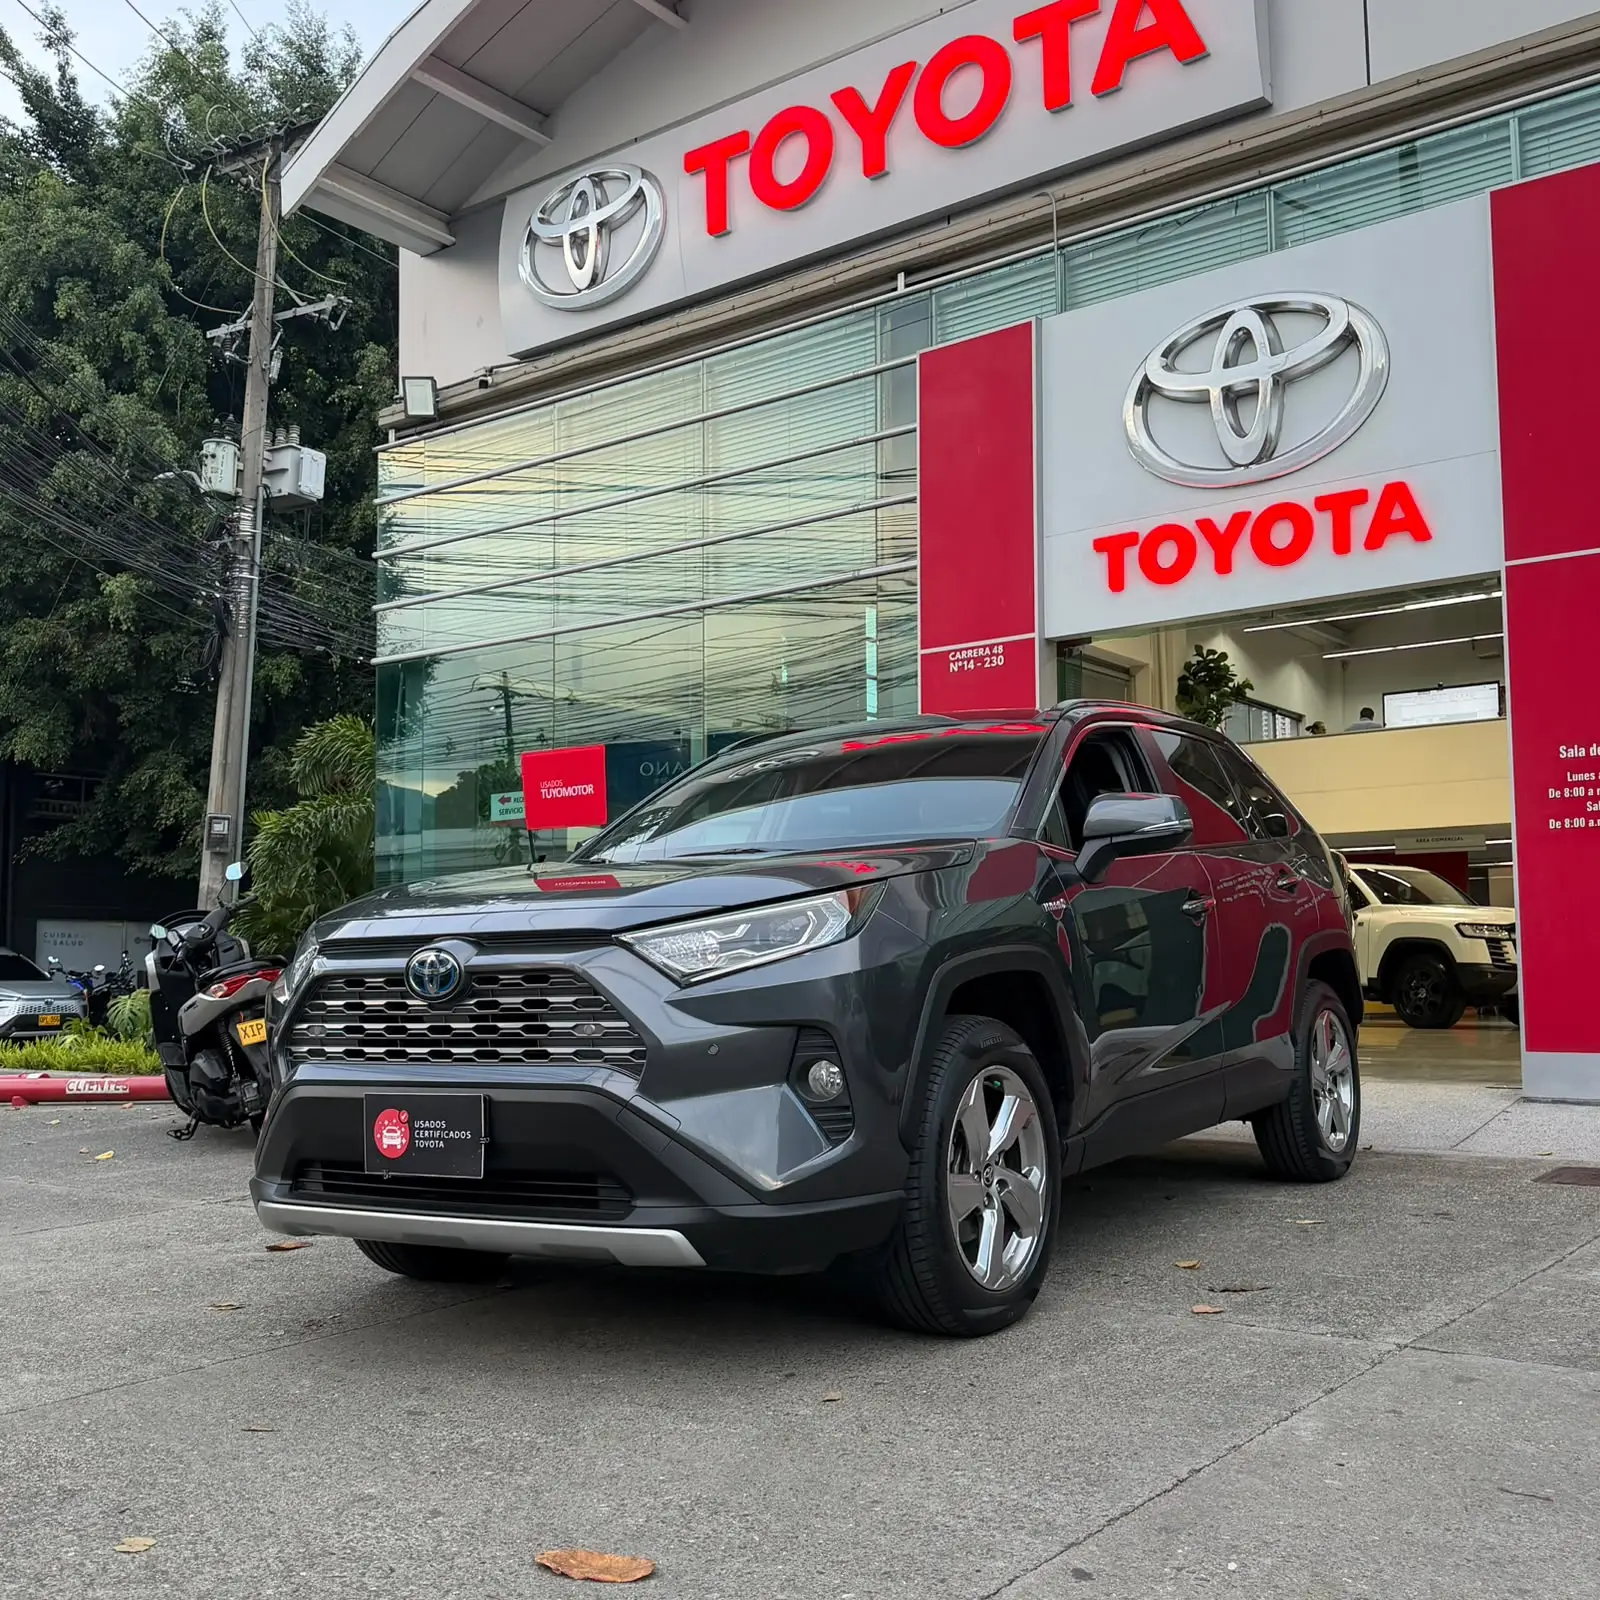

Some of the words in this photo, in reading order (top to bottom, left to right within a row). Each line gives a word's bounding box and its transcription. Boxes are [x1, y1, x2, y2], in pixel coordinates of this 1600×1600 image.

[684, 0, 1209, 237] TOYOTA
[1093, 481, 1432, 592] TOYOTA
[949, 646, 991, 661] CARRERA
[992, 644, 1004, 654] 48
[983, 655, 1005, 668] 230
[1559, 744, 1586, 759] Sala
[1567, 771, 1596, 782] Lunes
[540, 779, 563, 788] USADOS
[540, 784, 595, 799] TUYOMOTOR
[1548, 788, 1561, 799] De
[1563, 786, 1585, 798] 8:00
[1587, 788, 1594, 796] a
[498, 806, 524, 816] SERVICIO
[1549, 818, 1562, 829] De
[1564, 817, 1586, 829] 8:00
[43, 931, 72, 939] CUIDA
[240, 1022, 264, 1040] XIP
[67, 1080, 128, 1092] CLIENTES
[414, 1120, 447, 1129] USADOS
[414, 1130, 472, 1140] CERTIFICADOS
[414, 1140, 445, 1149] TOYOTA
